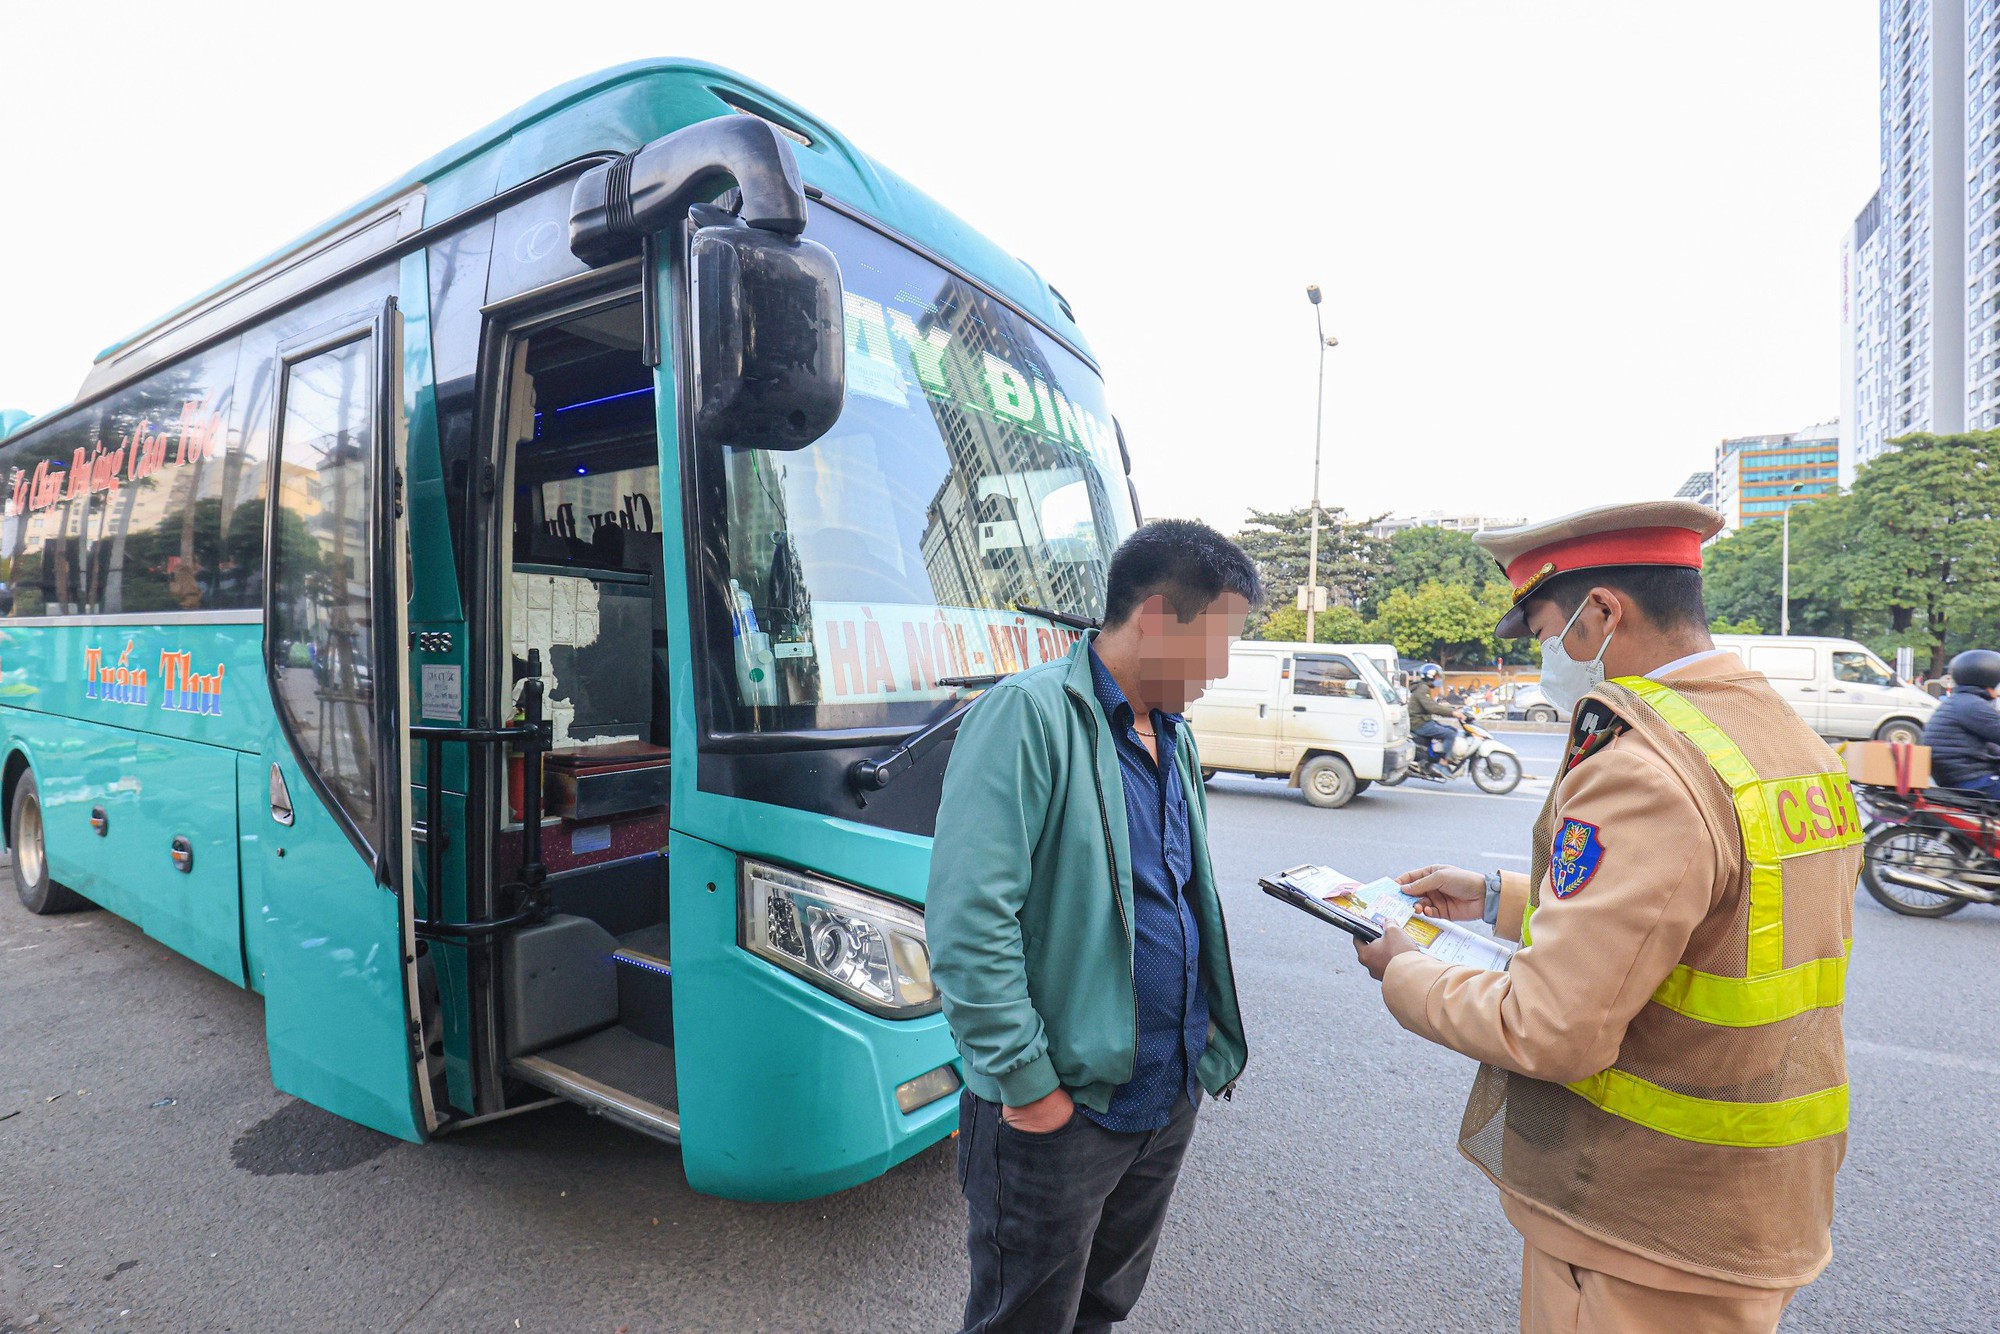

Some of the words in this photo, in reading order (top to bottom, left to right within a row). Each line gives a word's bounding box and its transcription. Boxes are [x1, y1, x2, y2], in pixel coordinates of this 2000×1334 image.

[128, 417, 167, 482] Cao
[84, 639, 148, 707] Tuấn
[158, 648, 224, 717] Thư
[826, 606, 897, 696] HÀ
[987, 617, 1030, 675] MỸ
